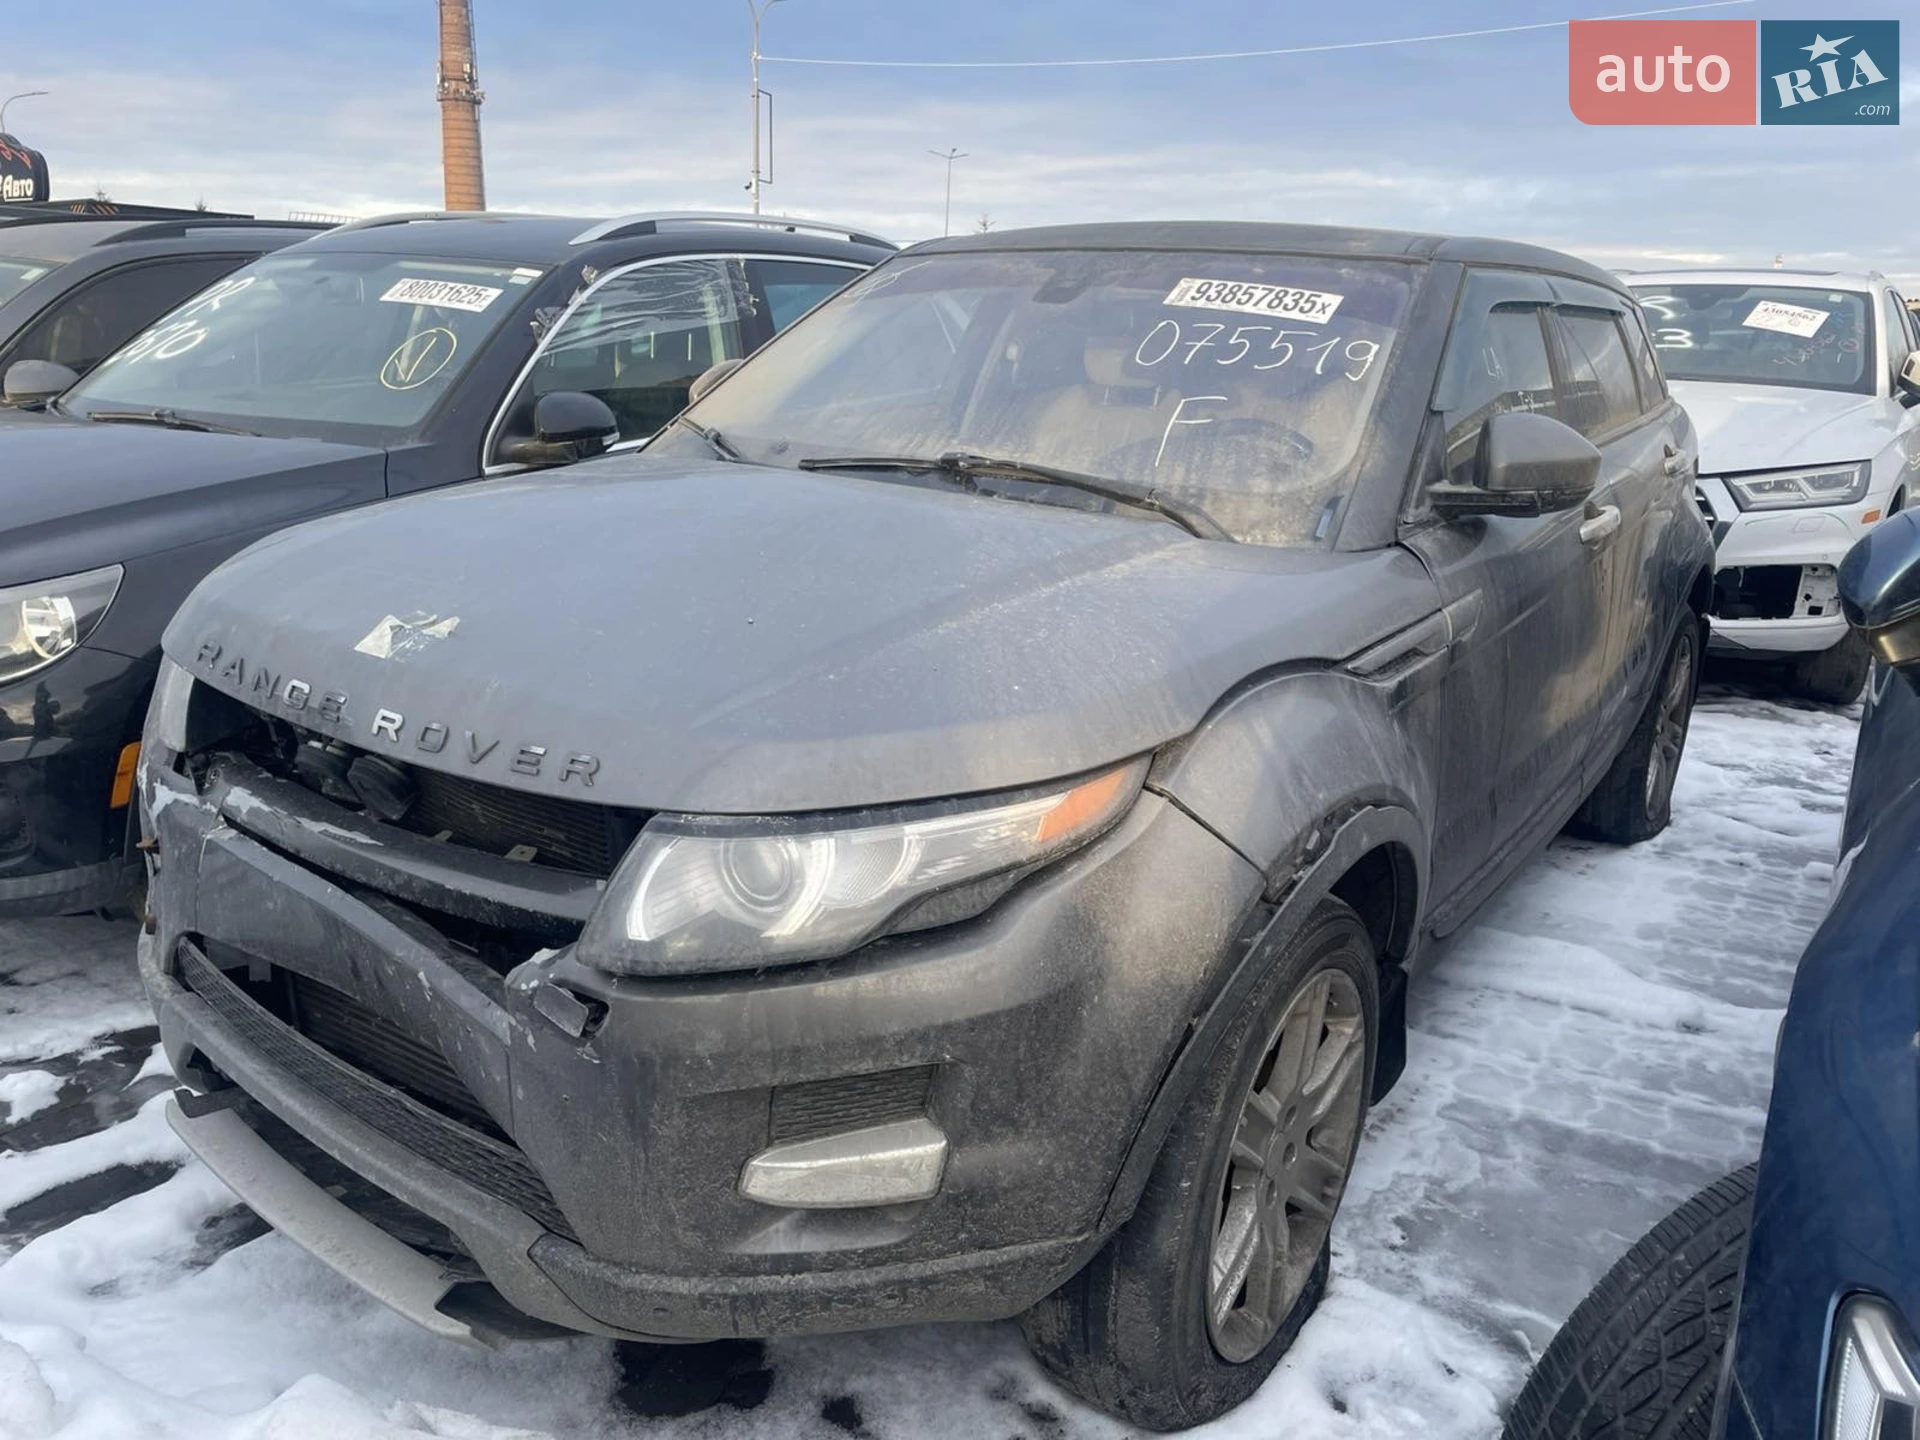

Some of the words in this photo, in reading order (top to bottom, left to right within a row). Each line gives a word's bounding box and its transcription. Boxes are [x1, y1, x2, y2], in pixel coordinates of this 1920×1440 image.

[1135, 319, 1381, 382] 075519
[1154, 395, 1229, 468] F
[196, 639, 348, 723] RANGE
[370, 708, 601, 787] ROVER
